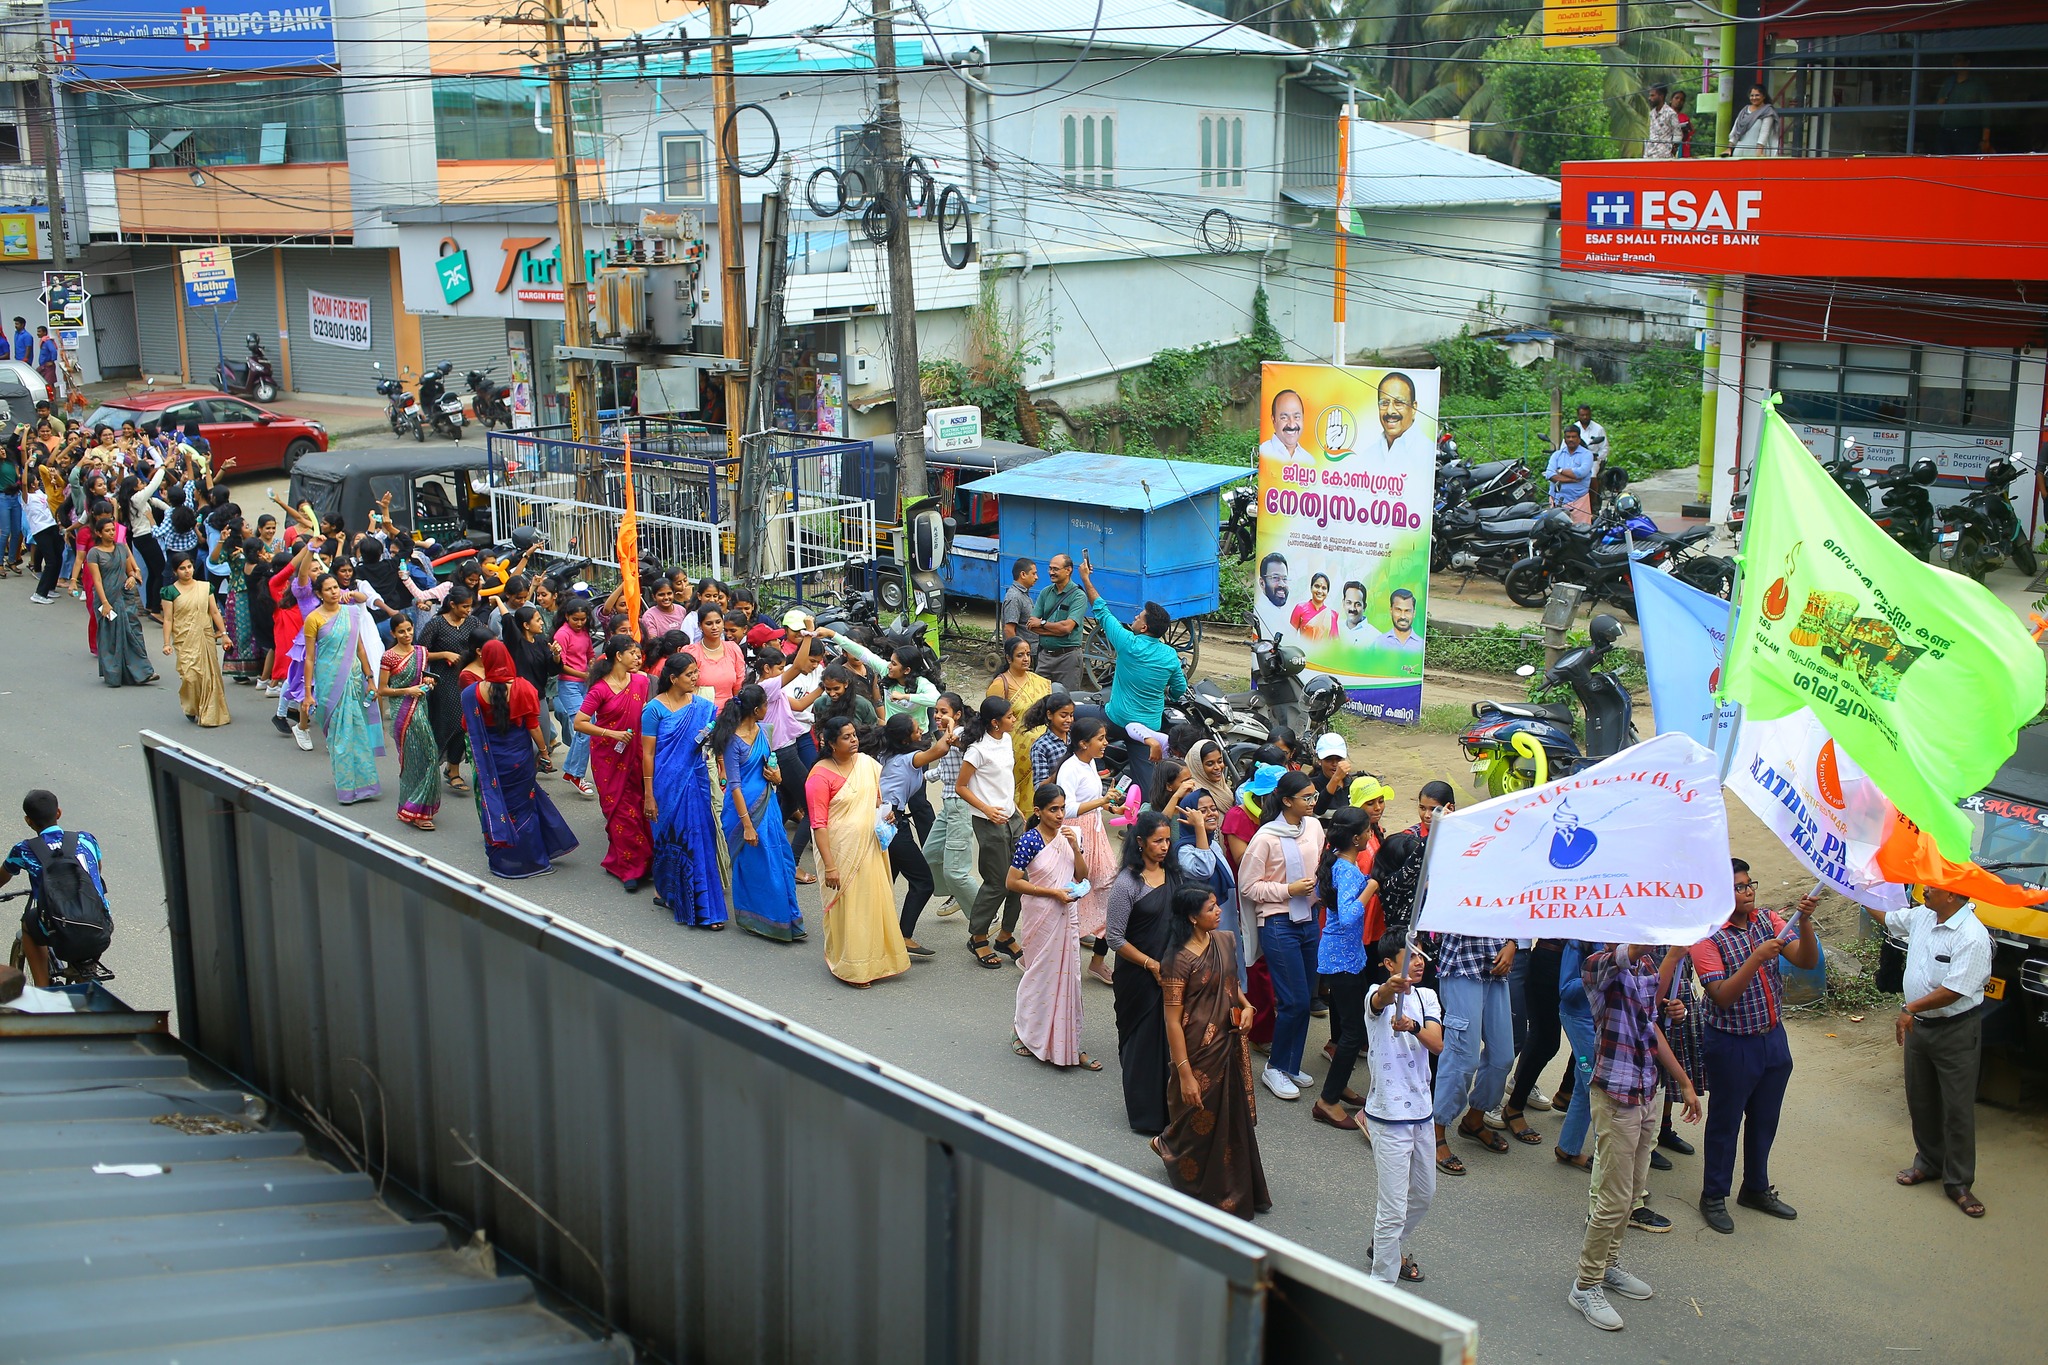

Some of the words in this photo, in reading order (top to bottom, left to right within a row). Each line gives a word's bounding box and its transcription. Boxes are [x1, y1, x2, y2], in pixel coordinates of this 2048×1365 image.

[213, 11, 264, 39] HDFC
[268, 6, 326, 34] BANK
[1642, 190, 1762, 231] ESAF
[1585, 234, 1613, 245] ESAF
[1616, 234, 1657, 245] SMALL
[1661, 234, 1718, 245] FINANCE
[1723, 234, 1760, 245] BANK
[1622, 253, 1655, 262] Branch
[193, 281, 229, 292] Alathur
[519, 291, 546, 300] MARGIN
[547, 292, 564, 300] FREE
[312, 296, 332, 317] ROOM
[333, 299, 347, 319] FOR
[349, 301, 367, 321] RENT
[313, 319, 367, 343] 6238001984
[1867, 447, 1894, 455] Savings
[1867, 454, 1896, 462] Account
[1954, 453, 1991, 463] Recurring
[1953, 461, 1982, 469] Deposit
[1282, 463, 1316, 487] ജില്ലാ
[1750, 752, 1818, 841] ALATHUR
[1458, 885, 1567, 907] ALATHUR
[1575, 881, 1704, 901] PALAKKAD
[1528, 901, 1627, 920] KERALA
